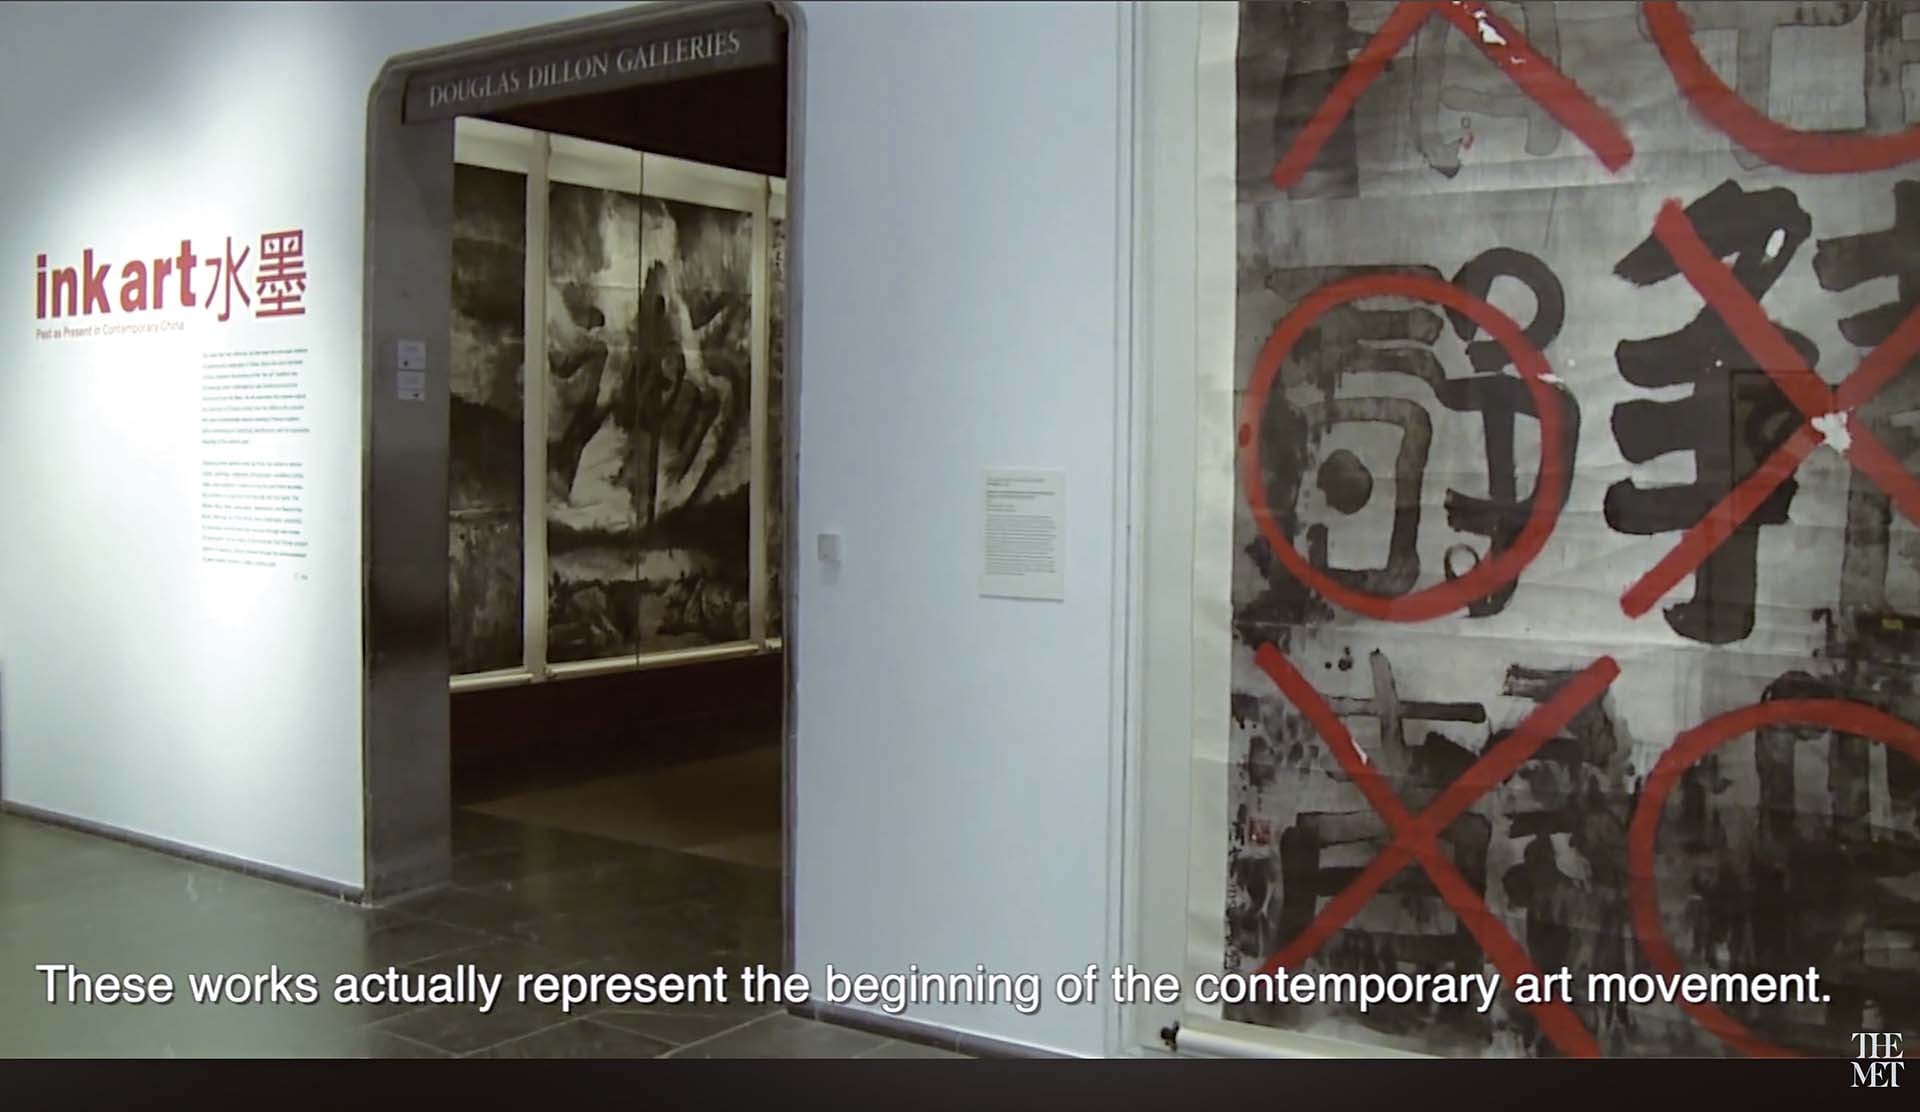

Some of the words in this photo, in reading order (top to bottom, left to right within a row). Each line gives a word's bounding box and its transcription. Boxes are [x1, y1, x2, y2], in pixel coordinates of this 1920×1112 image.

[429, 71, 520, 107] DOUGLAS
[528, 53, 609, 89] DILLON
[616, 30, 740, 72] GALLERIES
[36, 248, 111, 319] ink
[119, 239, 198, 313] art
[204, 229, 307, 322] 水墨
[63, 326, 92, 338] Present
[103, 322, 159, 336] Contemporary
